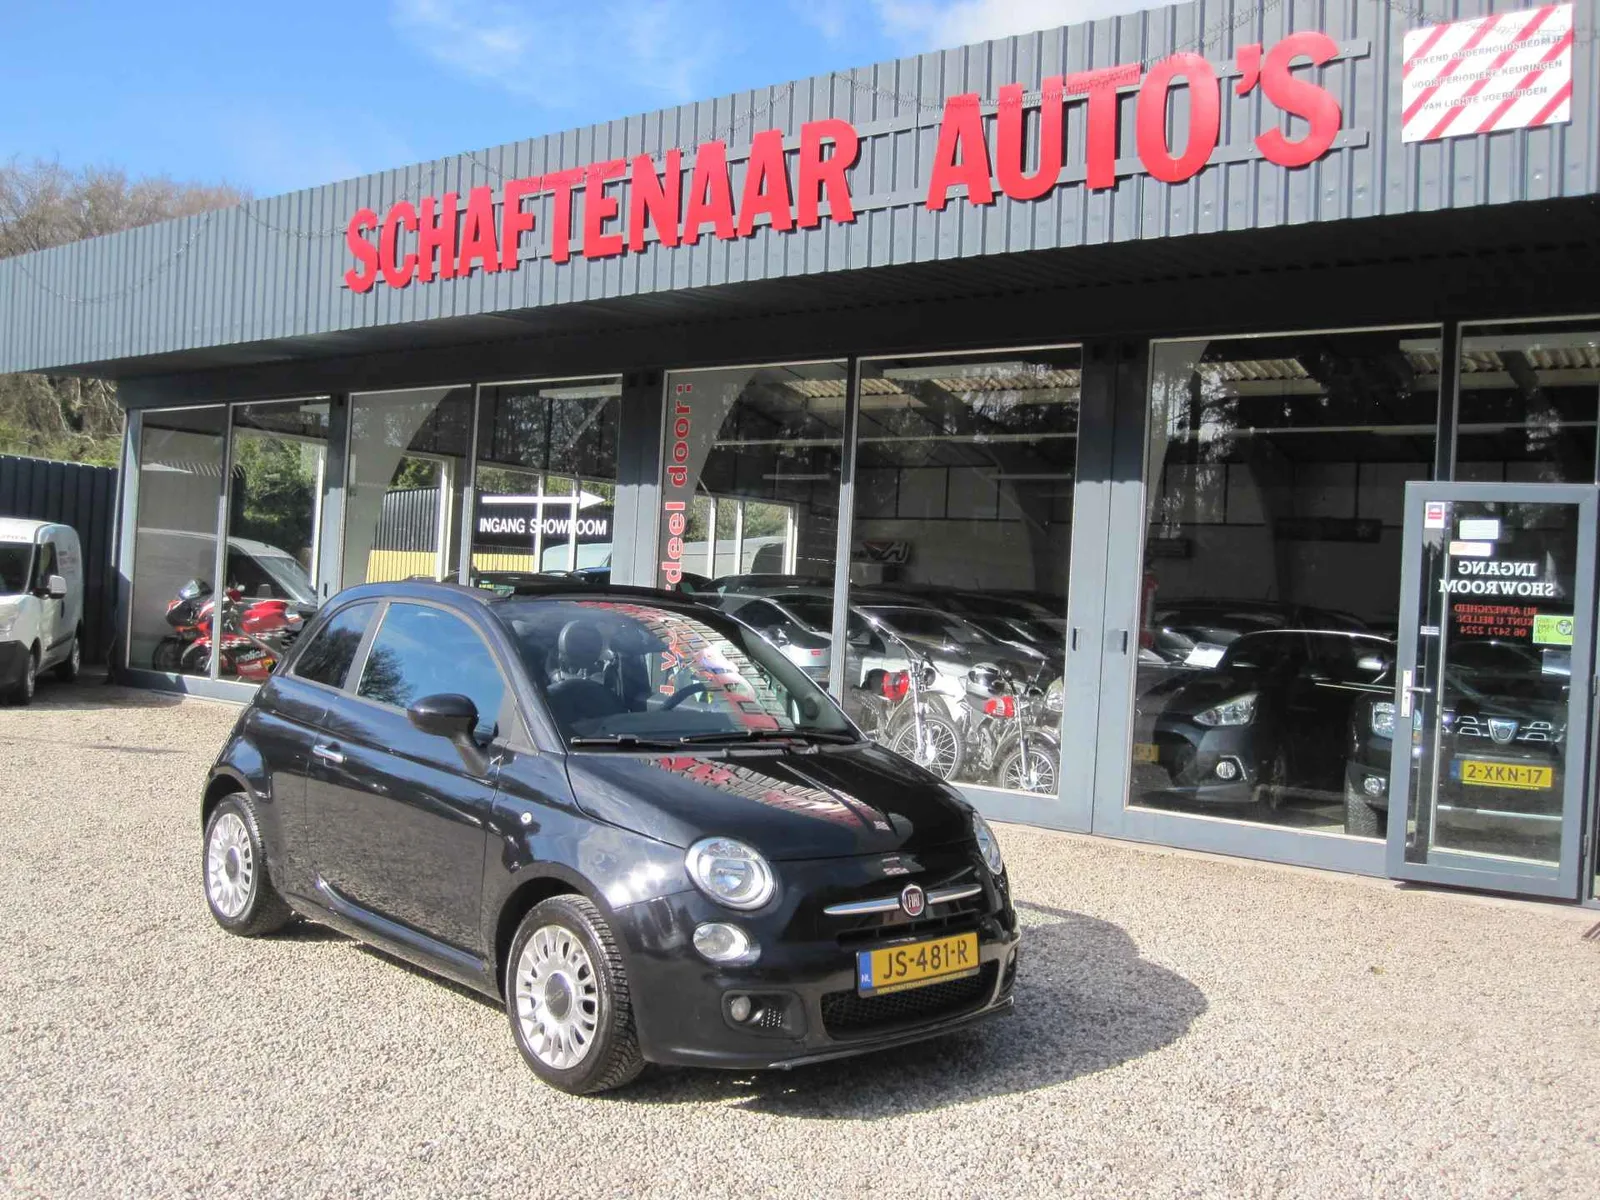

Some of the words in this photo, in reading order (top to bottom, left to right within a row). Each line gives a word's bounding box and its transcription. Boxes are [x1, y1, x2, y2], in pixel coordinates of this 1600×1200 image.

[1410, 53, 1449, 67] ERKEND
[1452, 35, 1563, 59] ONDERHOUDSBEDRIJF
[1412, 79, 1440, 90] VOOR
[1440, 68, 1497, 86] PERIODIEKE
[1502, 60, 1563, 75] KEURINGEN
[1424, 101, 1441, 111] VAN
[1444, 95, 1480, 108] LICHTE
[1482, 86, 1548, 102] VOERTUIGEN
[345, 118, 859, 294] SCHAFTENAAR
[925, 30, 1341, 211] AUTO'S
[667, 383, 693, 488] door:
[479, 518, 526, 533] INGANG
[1467, 764, 1543, 784] 2-XKN-17
[883, 940, 968, 979] JS-481-R
